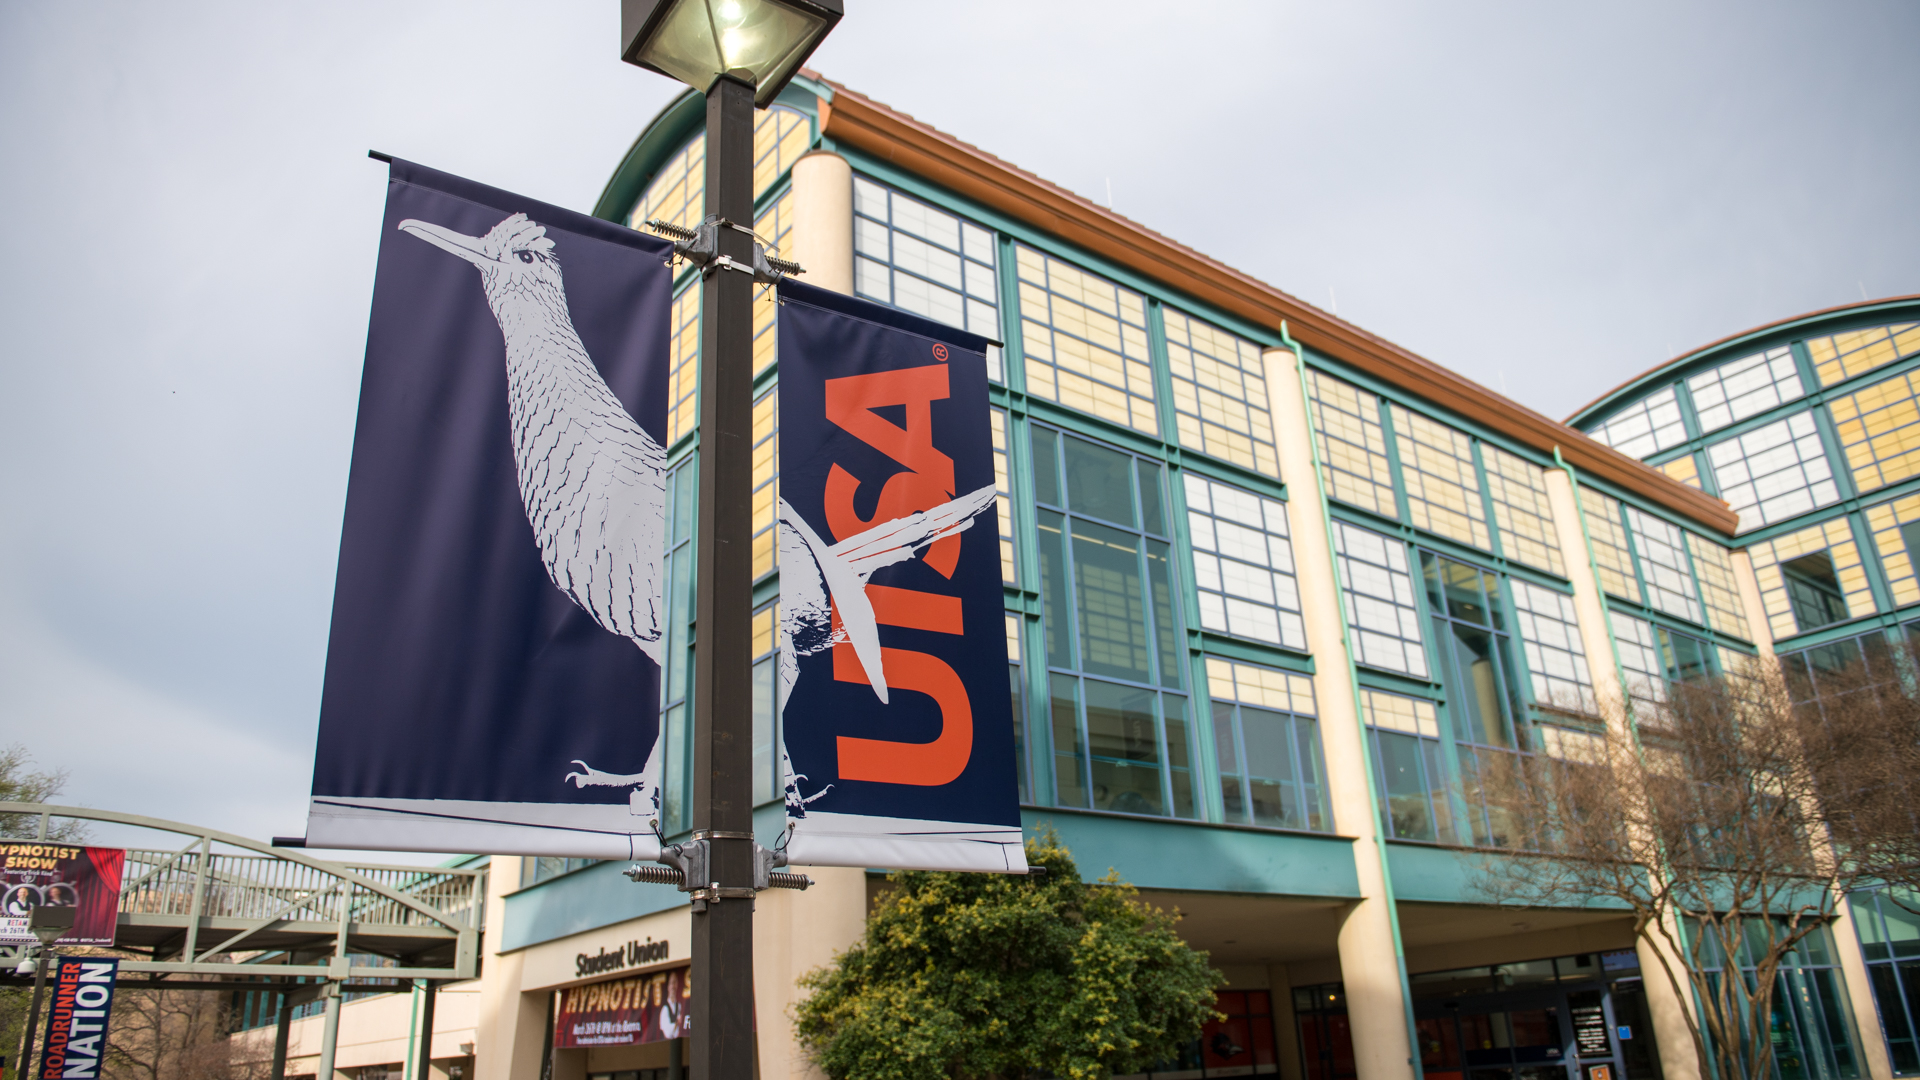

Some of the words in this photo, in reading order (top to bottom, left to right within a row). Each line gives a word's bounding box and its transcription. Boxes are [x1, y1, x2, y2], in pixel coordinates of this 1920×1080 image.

[0, 845, 81, 860] YPNOTIST
[4, 857, 58, 870] SHOW
[575, 946, 625, 977] Student
[627, 936, 669, 966] Union
[565, 973, 667, 1014] HYPNOTIST
[43, 963, 81, 1079] ROADRUNNER
[62, 963, 114, 1079] NATION
